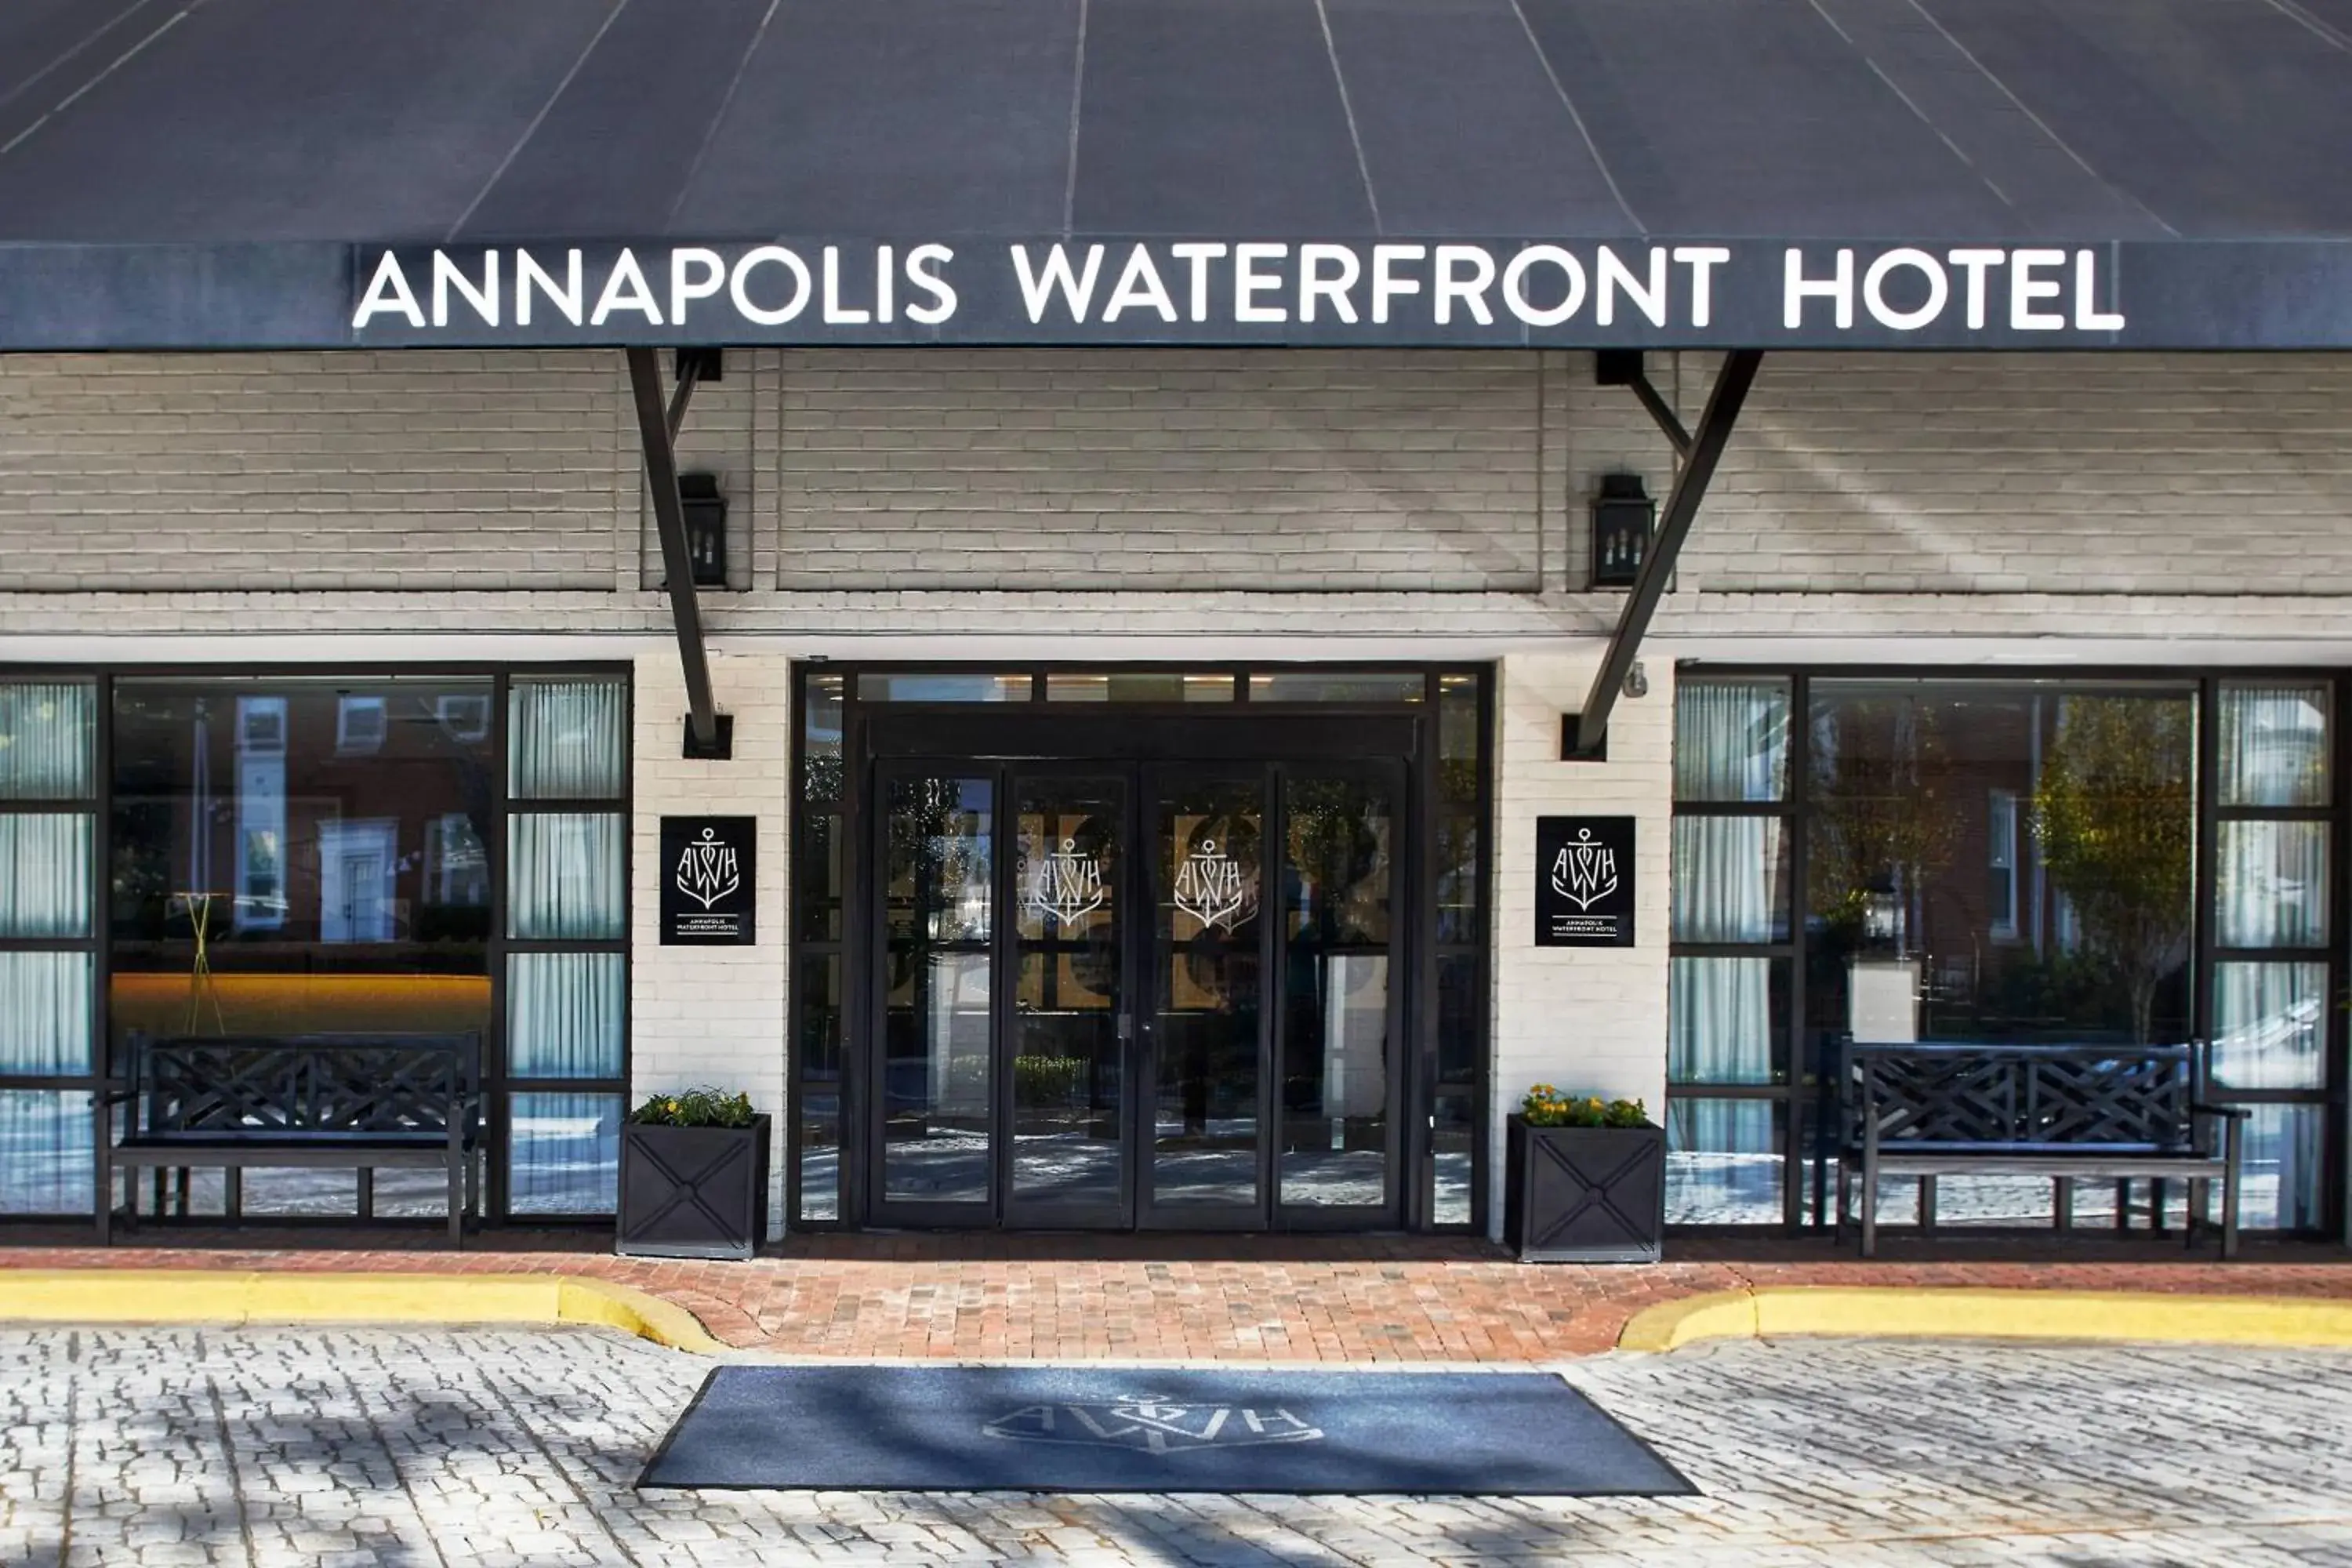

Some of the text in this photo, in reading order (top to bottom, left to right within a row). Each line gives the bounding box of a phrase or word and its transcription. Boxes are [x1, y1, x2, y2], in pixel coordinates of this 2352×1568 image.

[351, 243, 2125, 330] ANNAPOLIS WATERFRONT HOTEL
